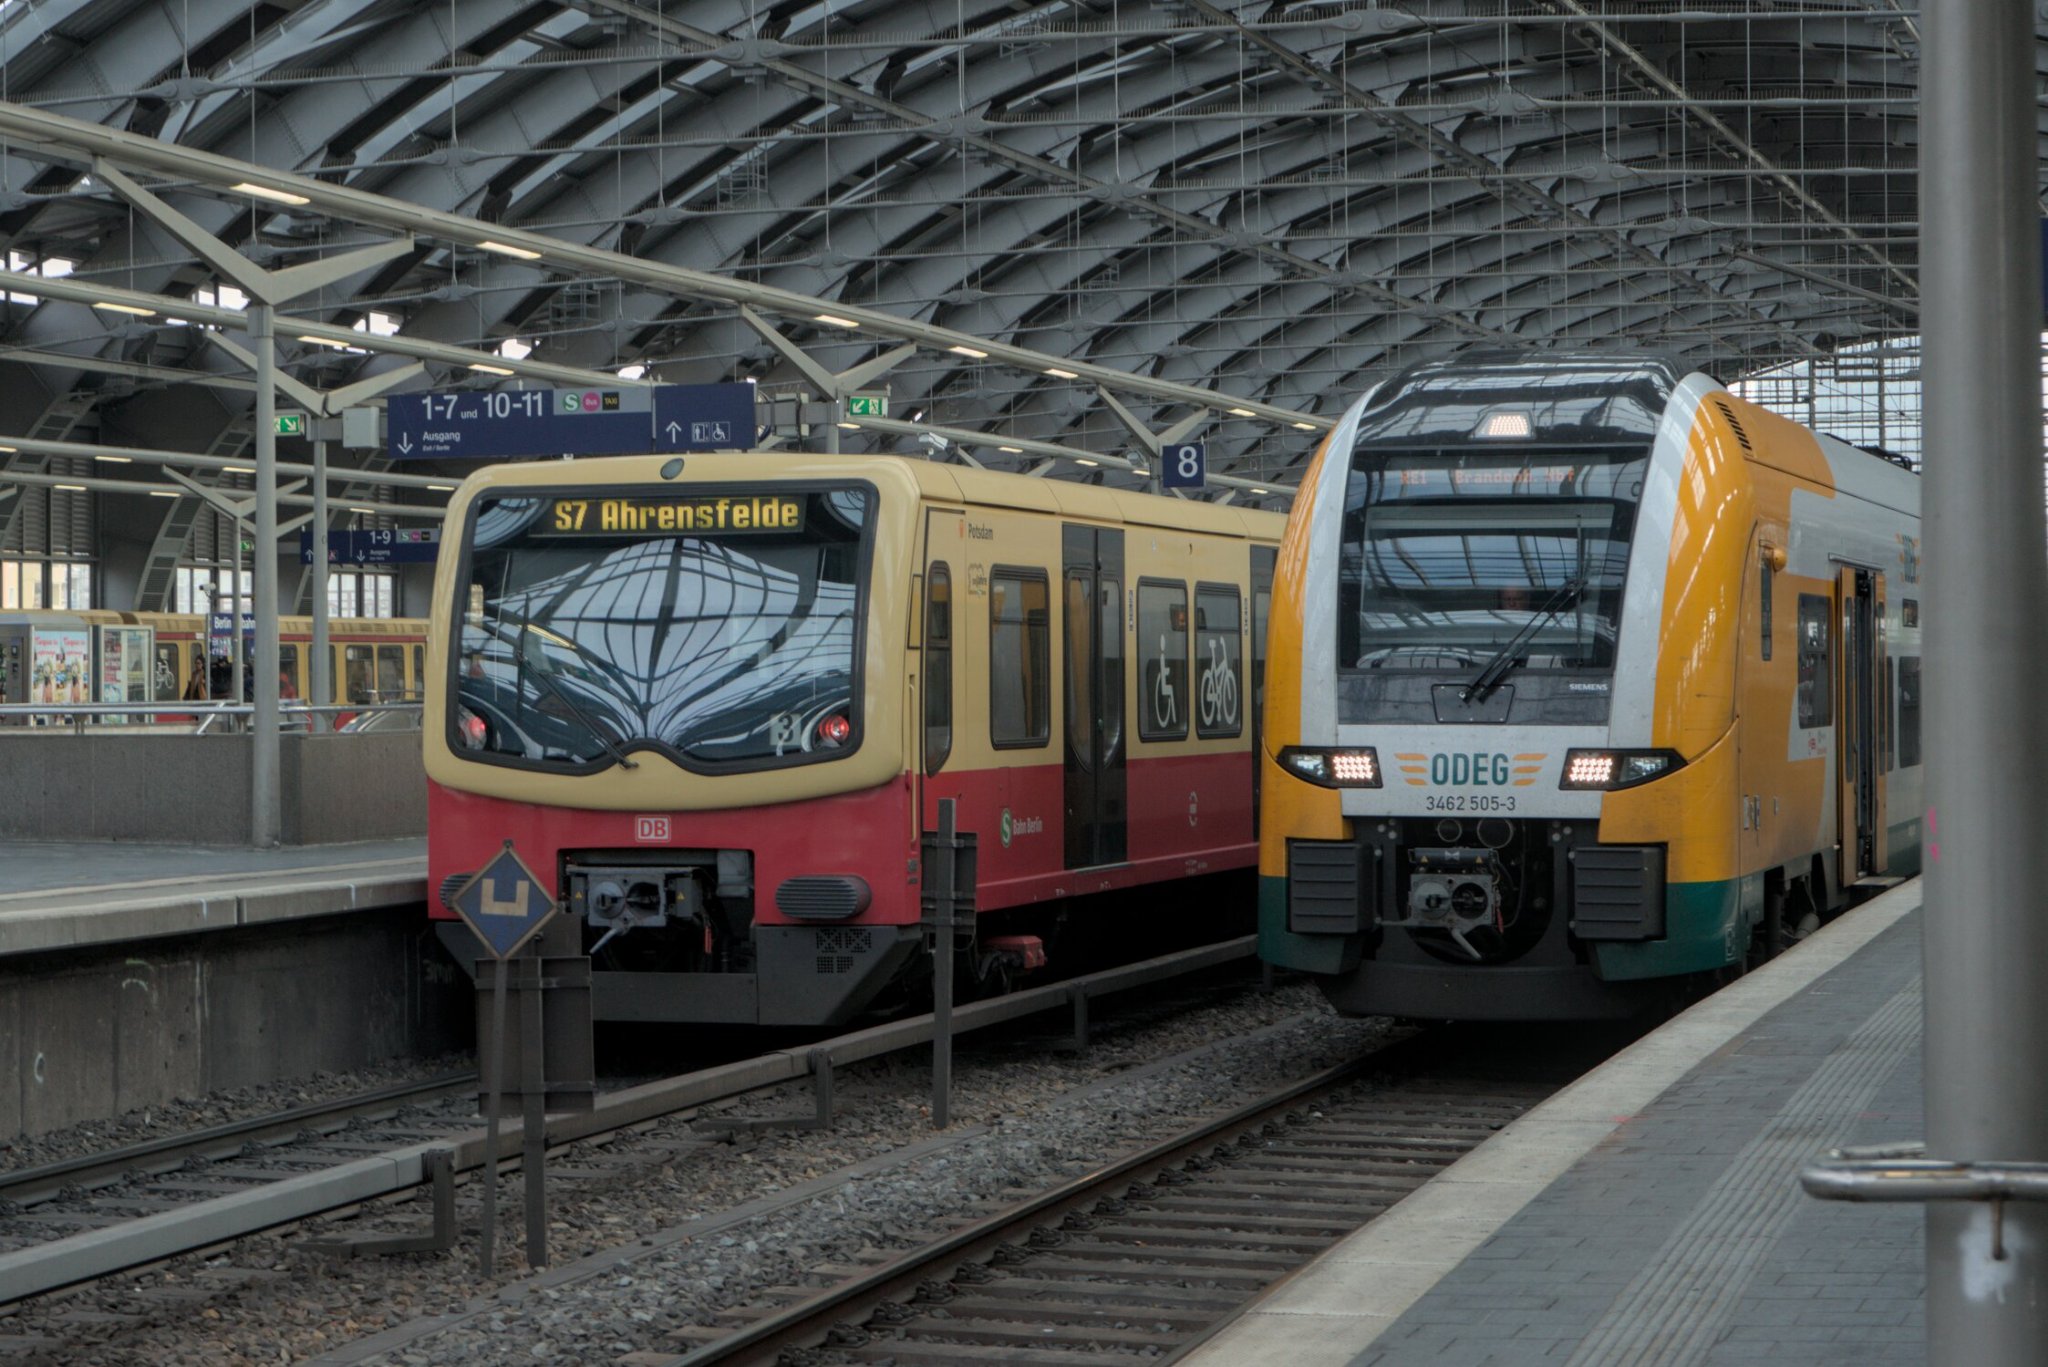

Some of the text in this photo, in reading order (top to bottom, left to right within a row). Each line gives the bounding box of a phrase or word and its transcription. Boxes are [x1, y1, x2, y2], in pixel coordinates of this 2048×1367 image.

[422, 392, 543, 420] 1-7 und 10-11
[565, 394, 578, 411] S
[422, 431, 460, 442] Ausgang
[1178, 445, 1198, 478] 8
[555, 498, 799, 531] S7 Ahrensfelde
[369, 530, 391, 544] 1-9
[968, 522, 993, 540] Potsdam
[214, 615, 232, 629] Berlin
[1569, 683, 1608, 691] SIEMENS
[778, 714, 794, 743] 3
[1431, 753, 1509, 786] ODEG
[1426, 796, 1516, 811] 3462 505-3
[640, 820, 666, 837] DB
